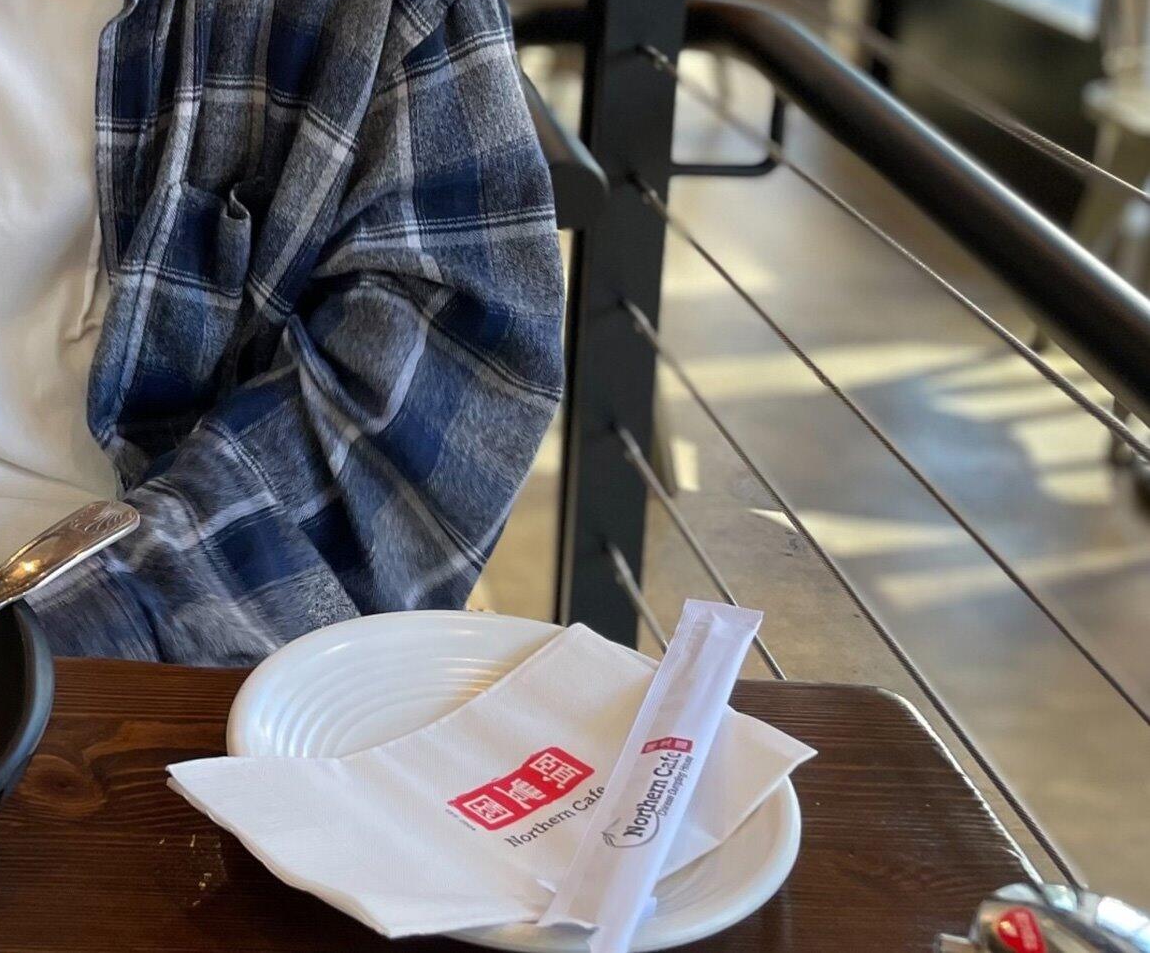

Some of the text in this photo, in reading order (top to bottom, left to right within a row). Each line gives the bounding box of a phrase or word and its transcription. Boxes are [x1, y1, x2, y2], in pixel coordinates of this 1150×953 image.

[504, 810, 572, 848] Northern
[572, 785, 605, 813] Cafe
[622, 779, 668, 838] Northern
